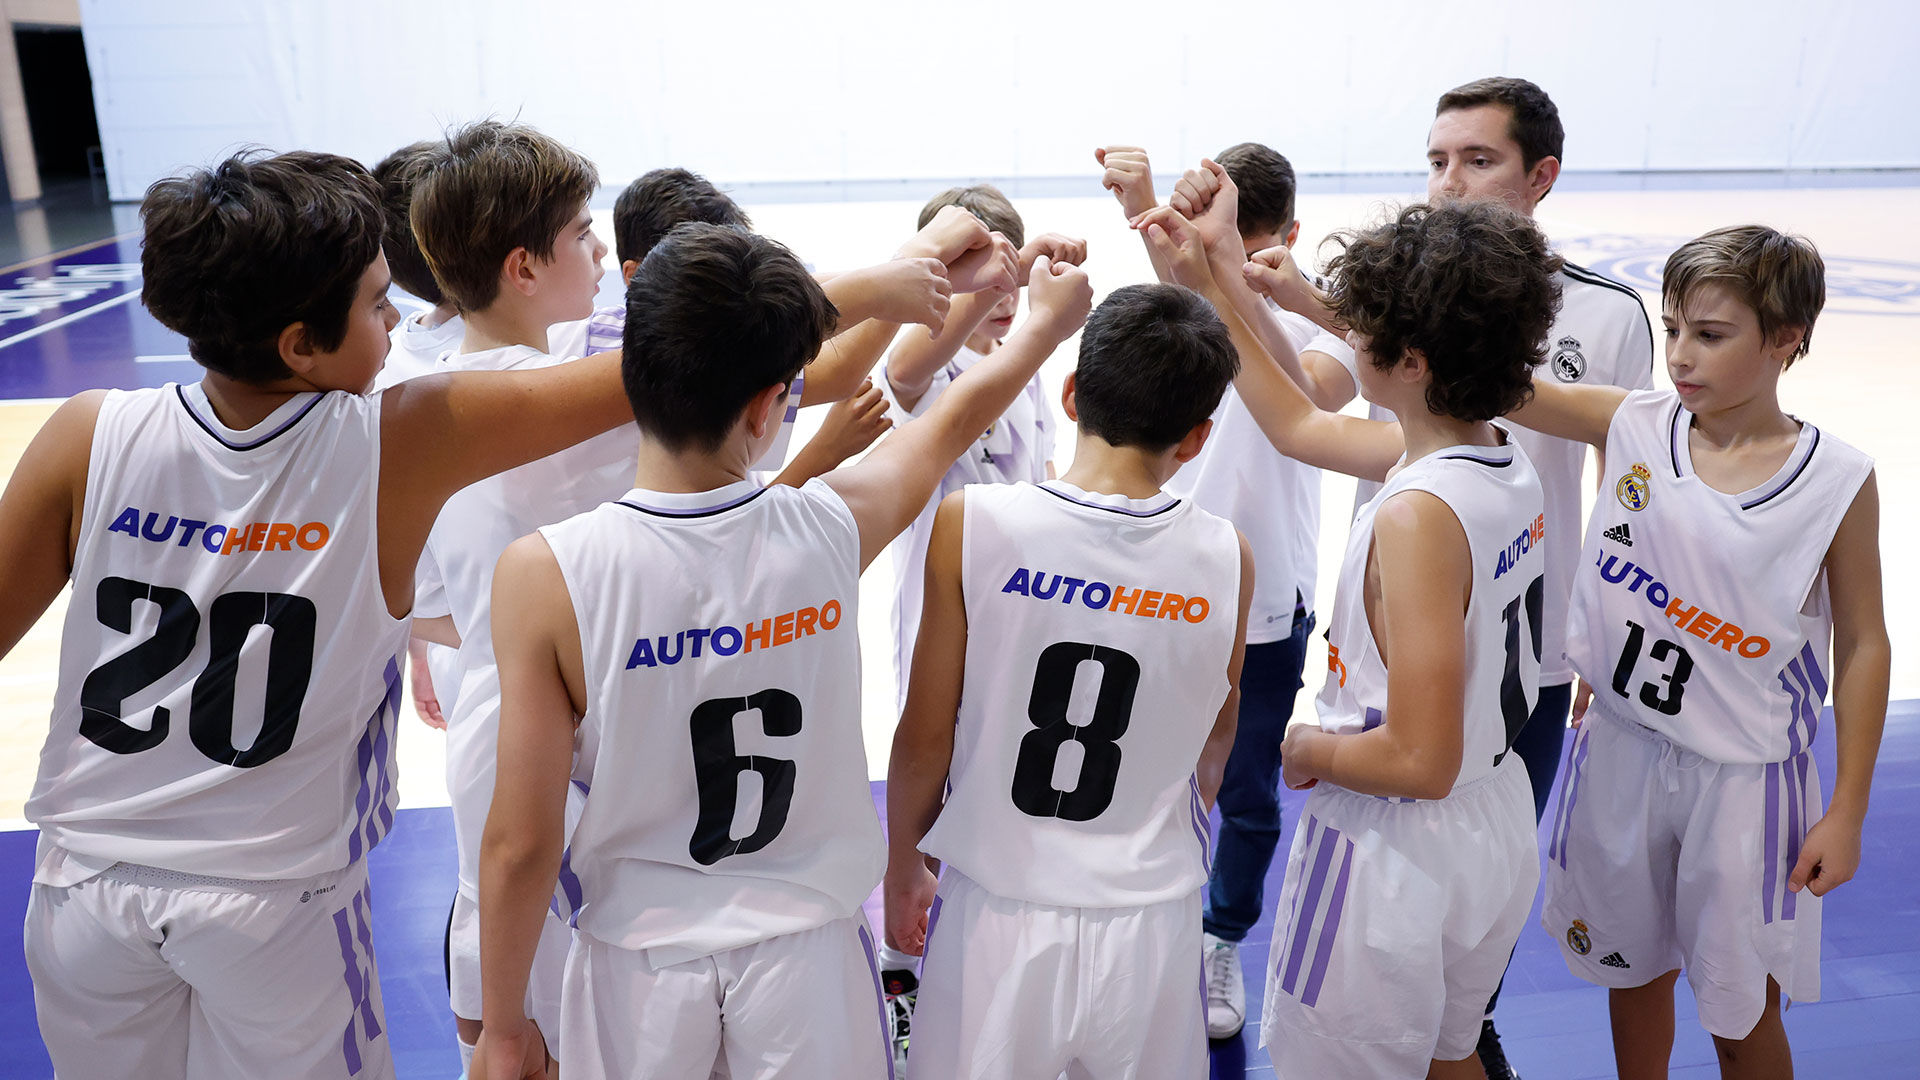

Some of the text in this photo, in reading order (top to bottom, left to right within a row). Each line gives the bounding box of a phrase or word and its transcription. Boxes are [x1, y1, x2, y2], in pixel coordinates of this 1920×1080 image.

[108, 507, 330, 555] AUTOHERO
[1493, 513, 1544, 580] AUTOHE
[1603, 530, 1633, 547] adidas
[1001, 567, 1210, 624] AUTOHERO
[625, 599, 842, 670] AUTOHERO
[1611, 619, 1695, 716] 13
[79, 576, 317, 769] 20
[1011, 641, 1141, 822] 8
[689, 688, 803, 866] 6
